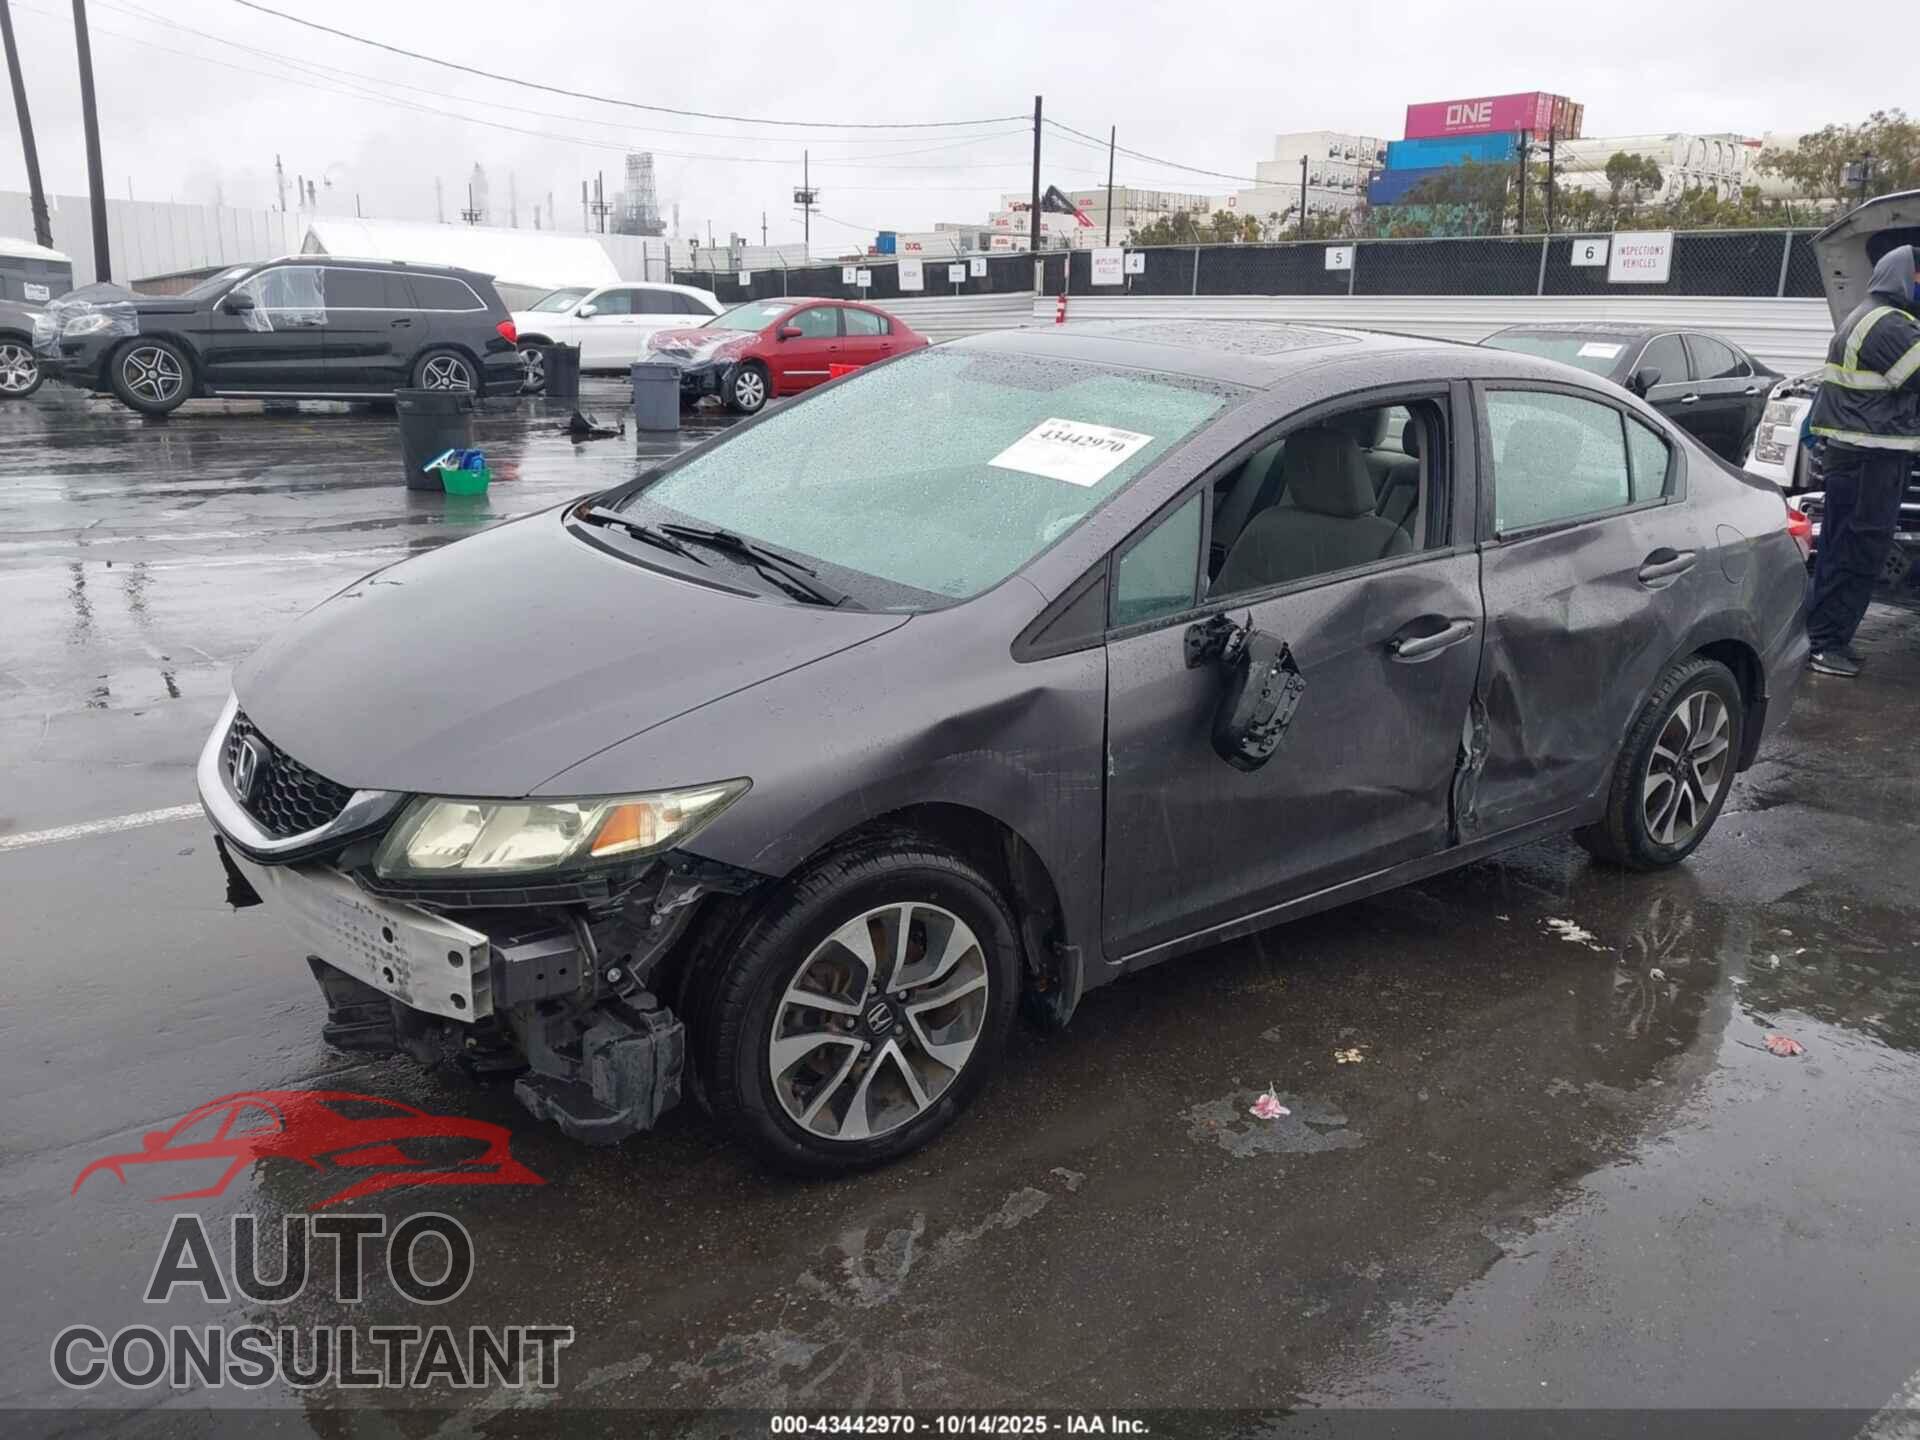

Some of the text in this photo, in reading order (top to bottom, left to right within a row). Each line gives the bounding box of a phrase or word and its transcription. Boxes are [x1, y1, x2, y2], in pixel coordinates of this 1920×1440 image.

[1446, 102, 1493, 125] ONE
[1336, 252, 1343, 264] 5
[1585, 246, 1594, 259] 6
[1623, 258, 1657, 269] VEHICLES
[1040, 430, 1126, 453] 43442970
